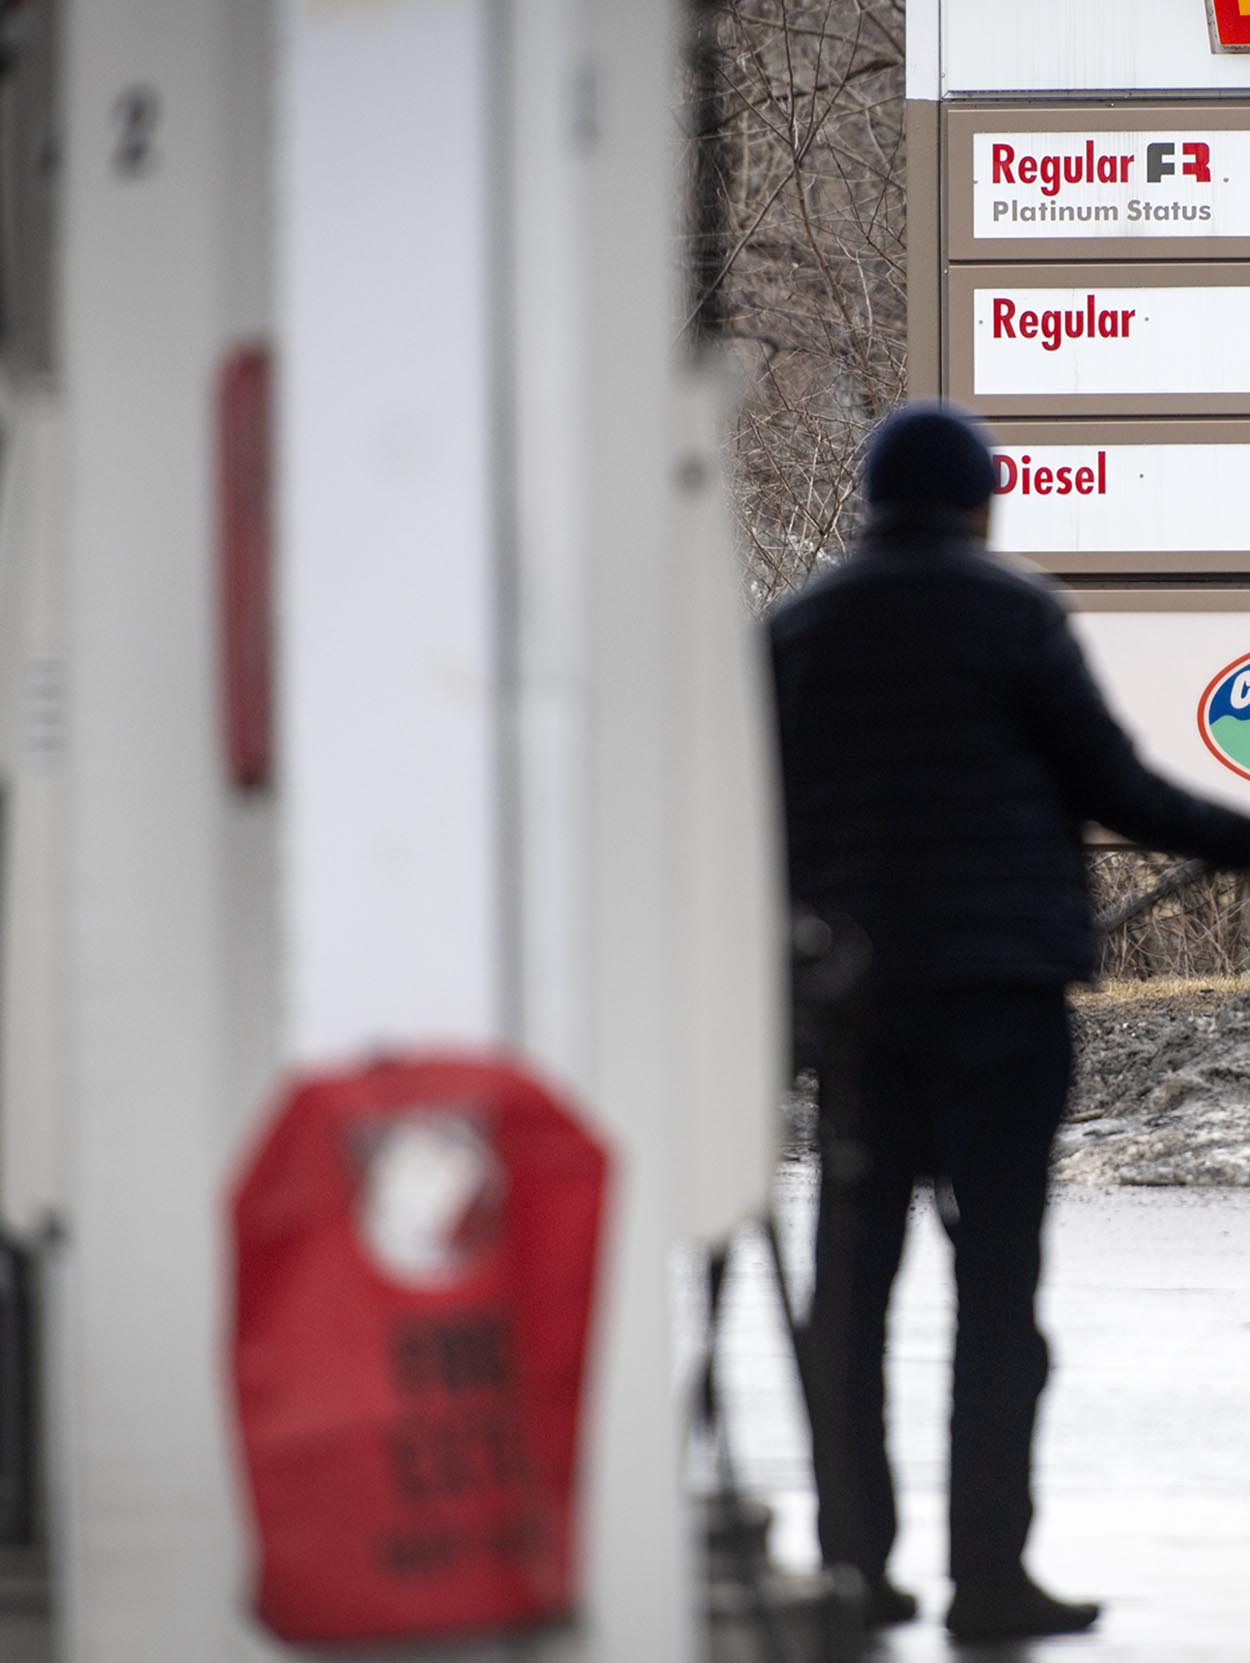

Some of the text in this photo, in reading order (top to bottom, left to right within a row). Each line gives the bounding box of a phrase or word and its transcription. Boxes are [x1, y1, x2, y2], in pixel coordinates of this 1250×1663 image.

[992, 140, 1135, 196] Regular
[992, 200, 1211, 222] Platinum Status
[992, 294, 1136, 351] Regular
[992, 451, 1106, 495] Diesel
